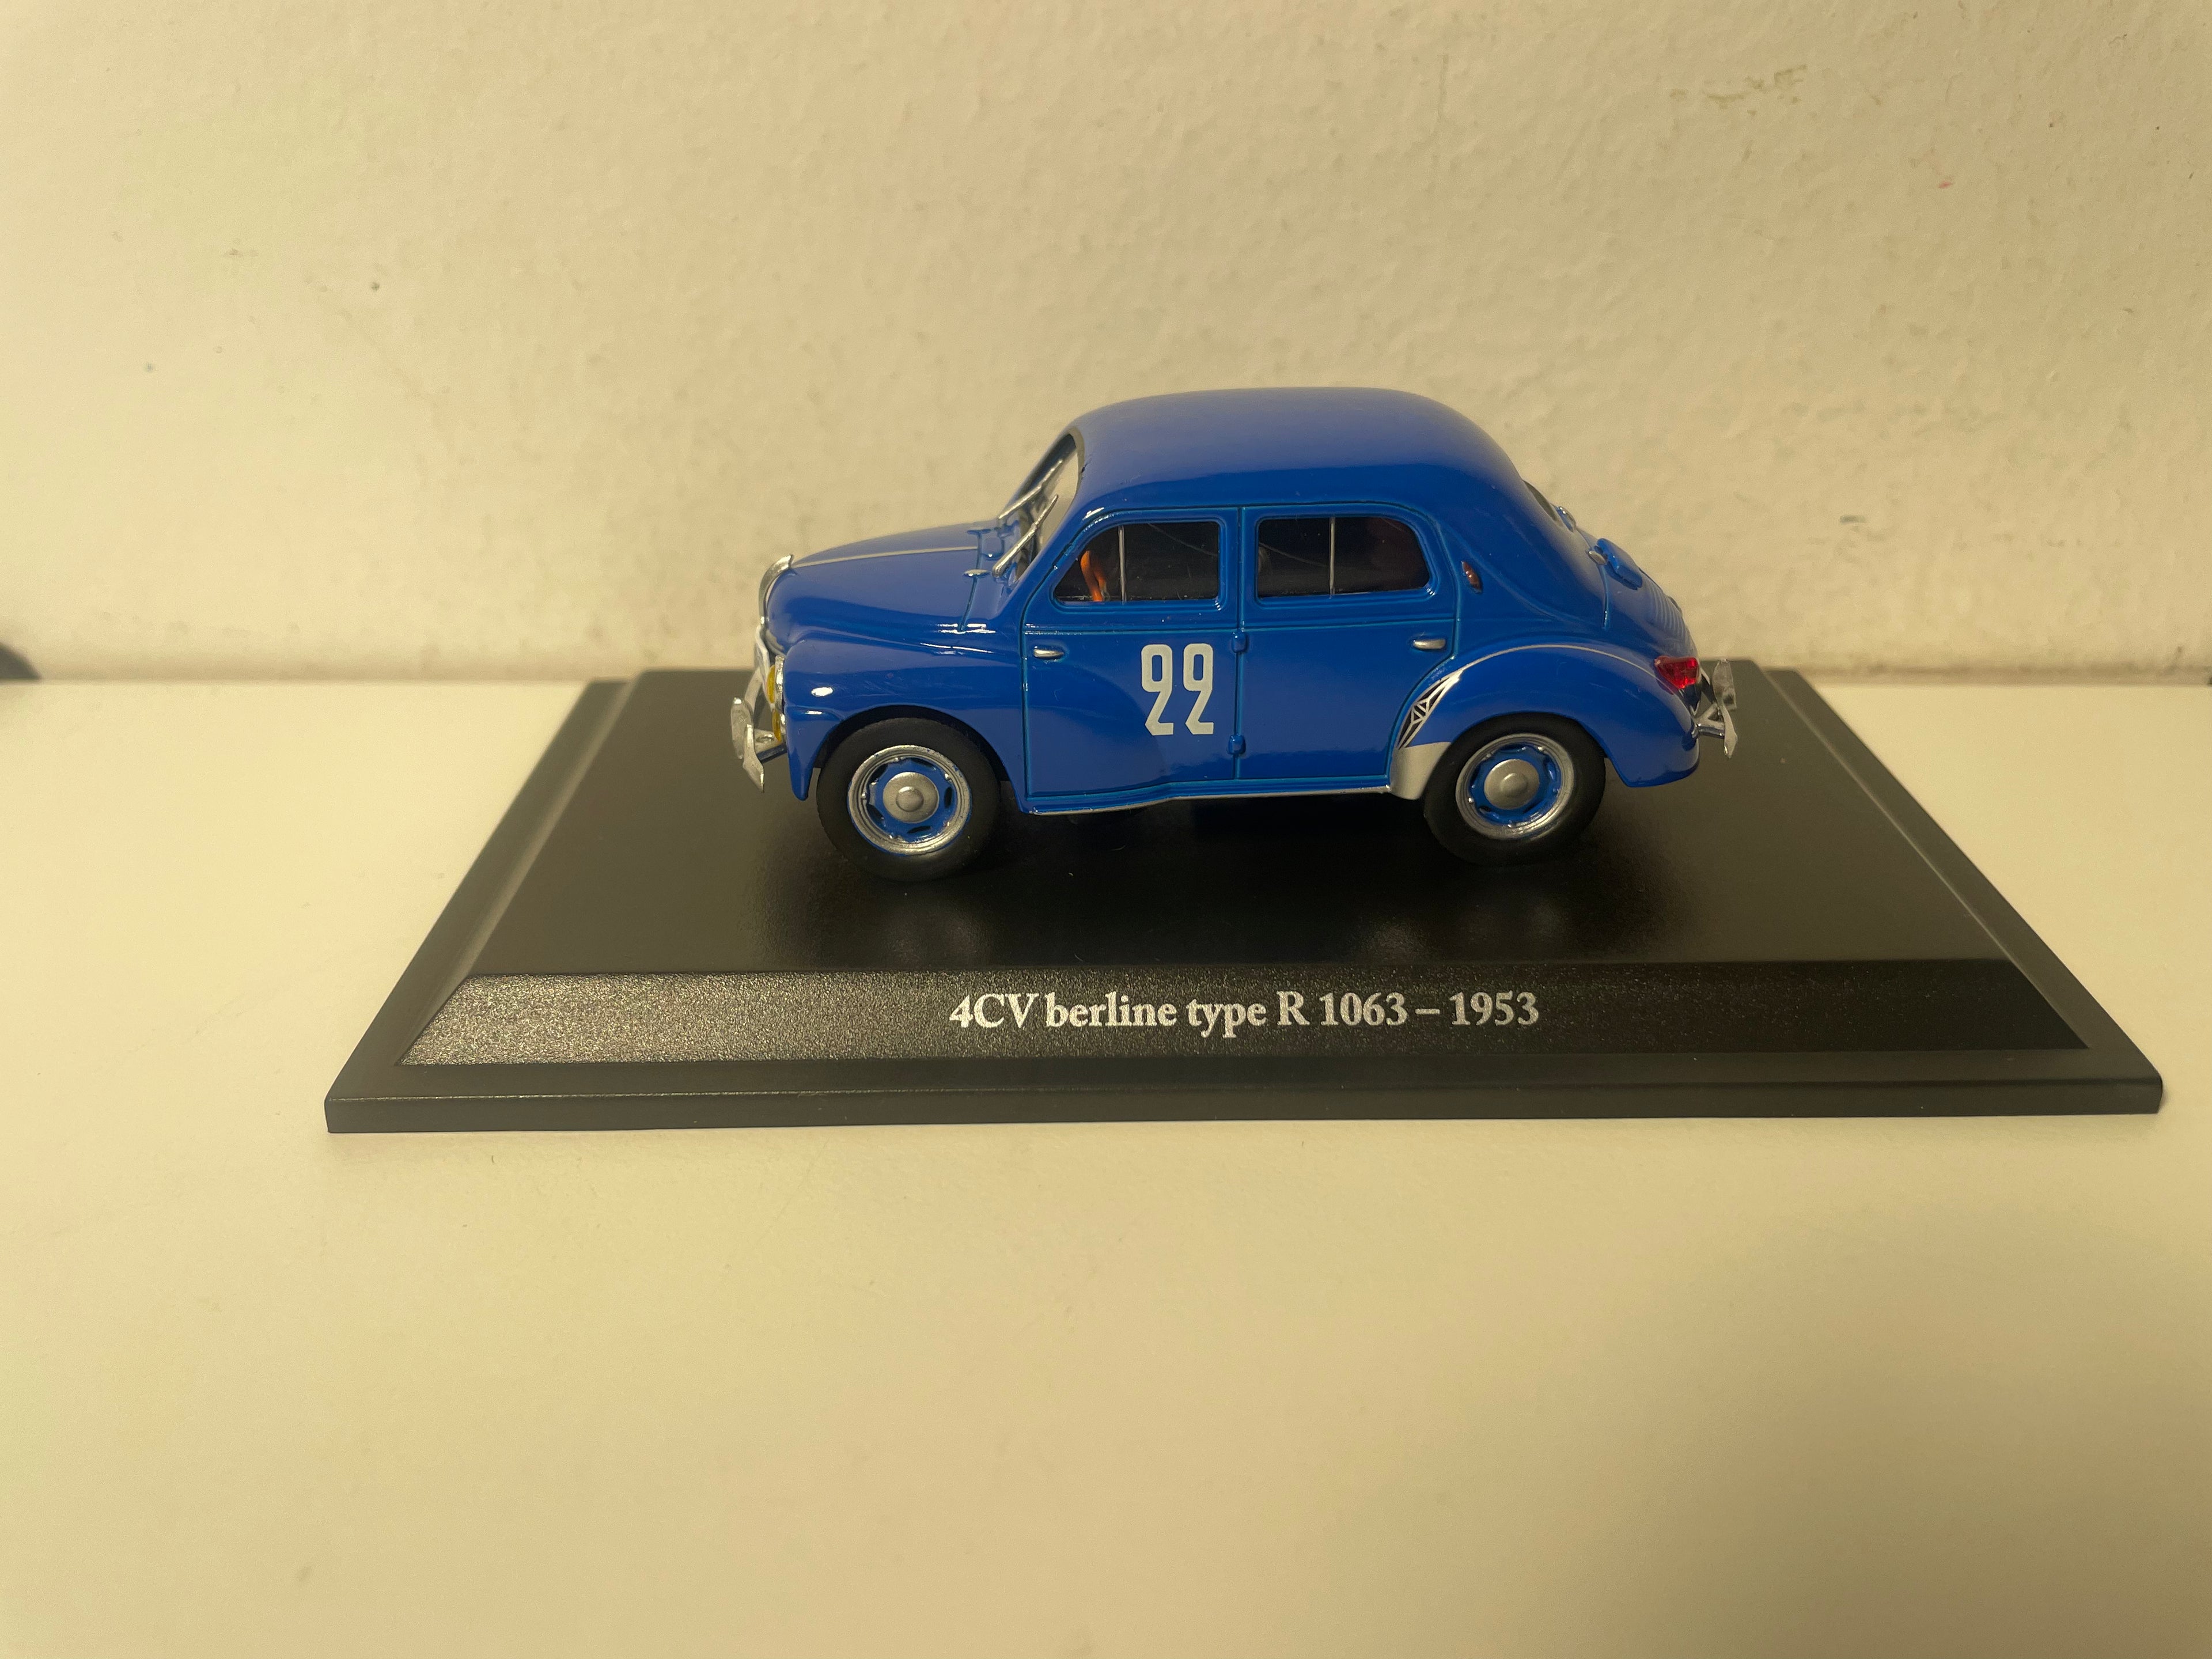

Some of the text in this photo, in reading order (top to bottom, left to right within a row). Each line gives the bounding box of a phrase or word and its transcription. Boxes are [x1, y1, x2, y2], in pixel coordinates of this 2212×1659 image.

[949, 993, 1040, 1028] 4CV
[1043, 990, 1177, 1028] berline
[1185, 998, 1267, 1039] type
[1276, 990, 1310, 1026] R
[1319, 991, 1408, 1026] 1063
[1449, 990, 1540, 1025] 1953
